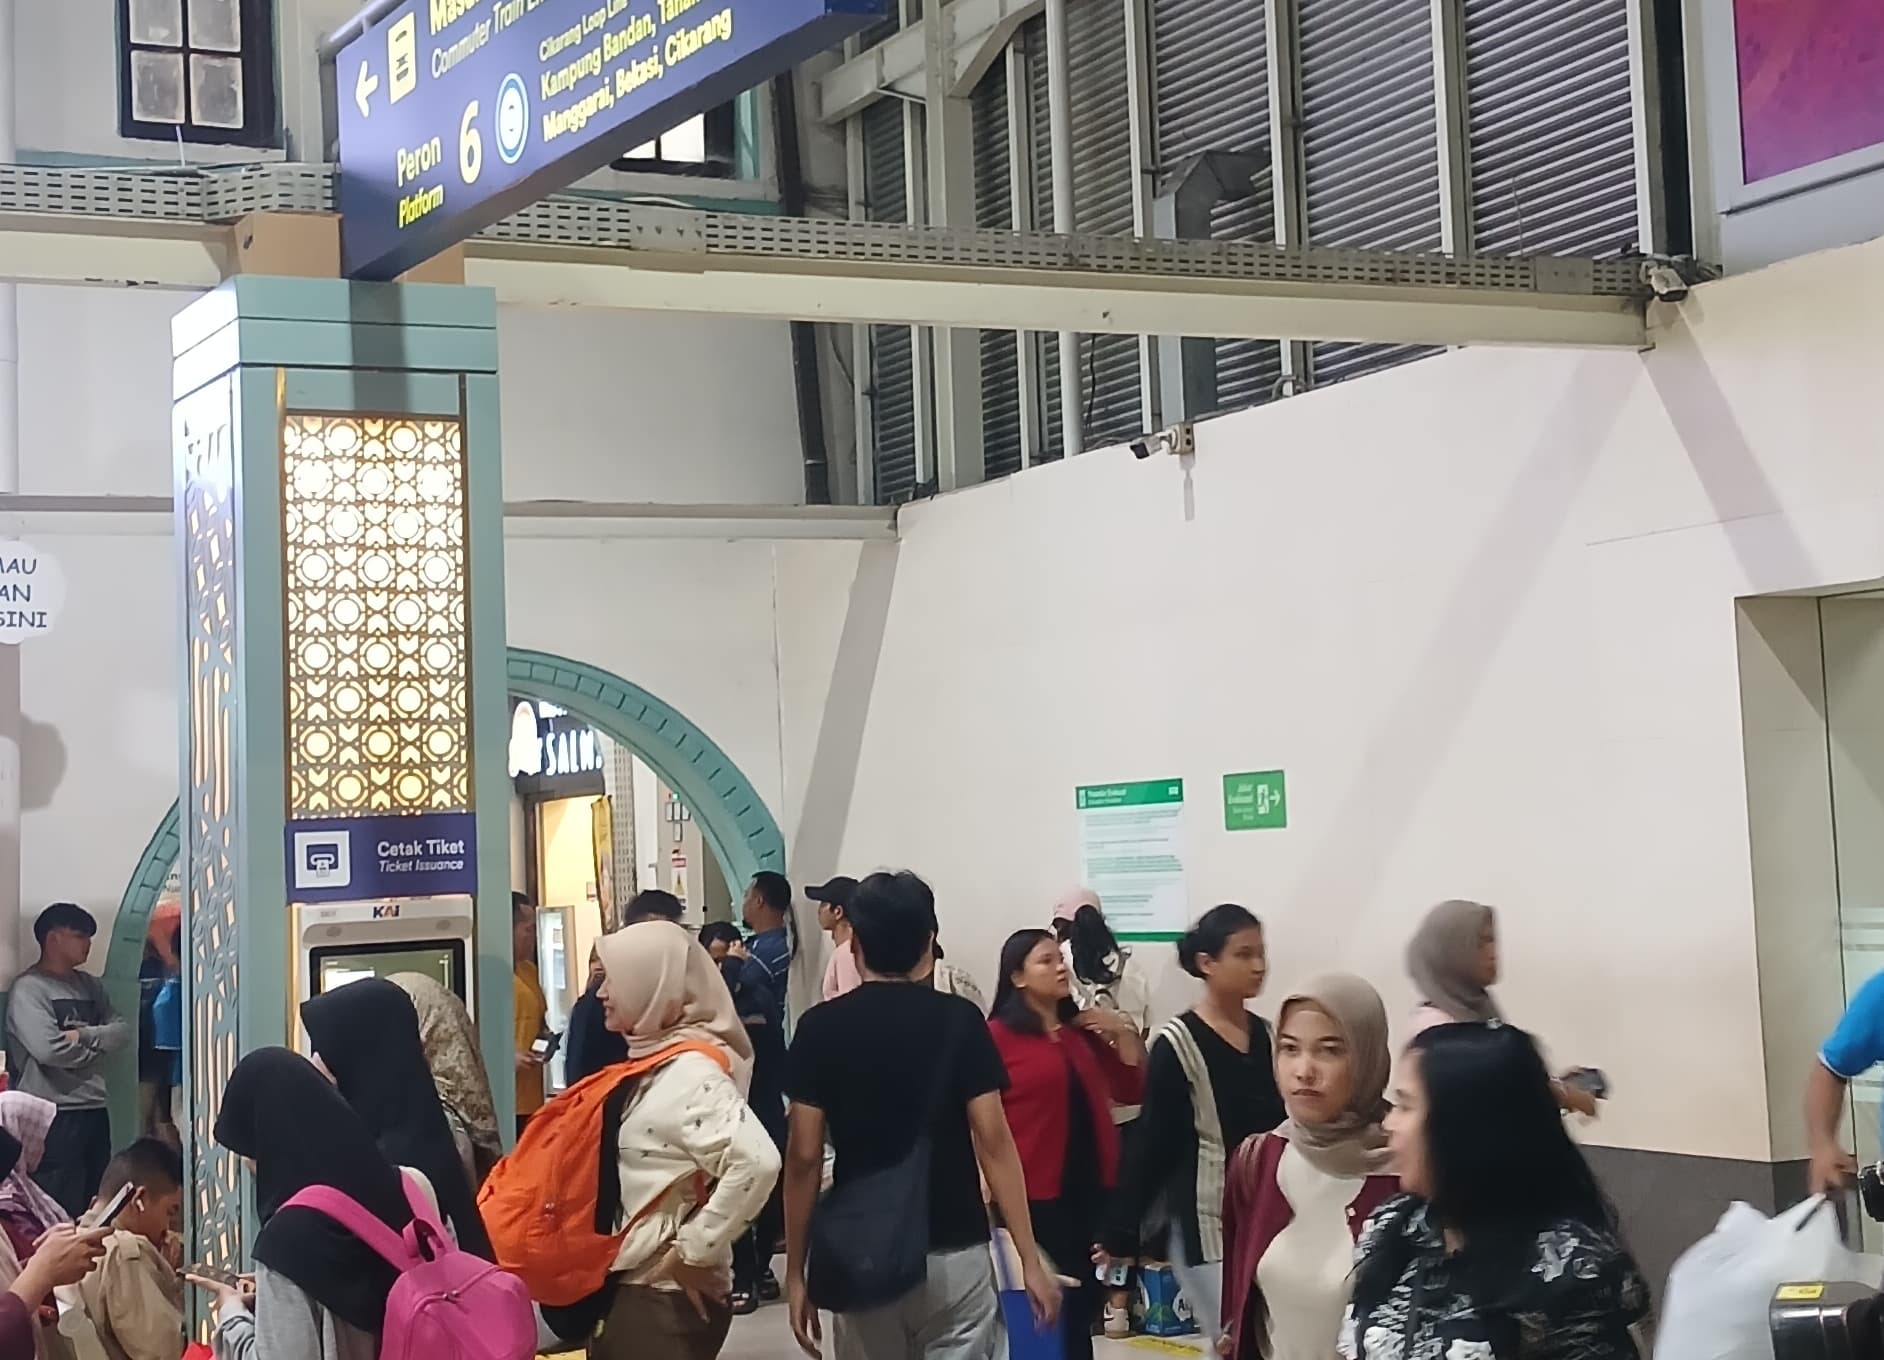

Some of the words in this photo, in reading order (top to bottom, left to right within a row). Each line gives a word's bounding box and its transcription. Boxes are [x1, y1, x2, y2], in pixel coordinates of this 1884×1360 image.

[431, 17, 491, 78] Commuter
[540, 47, 601, 100] Kampung
[603, 14, 656, 62] Bandan,
[543, 77, 615, 142] Manggarai,
[615, 45, 663, 98] Bekasi,
[664, 8, 732, 66] Cikarang
[397, 136, 442, 187] Peron
[459, 99, 482, 184] 6
[399, 184, 444, 228] Platform
[377, 840, 423, 857] Cetak
[426, 839, 465, 856] Tiket
[379, 860, 413, 873] Ticket
[415, 859, 464, 872] Issuance
